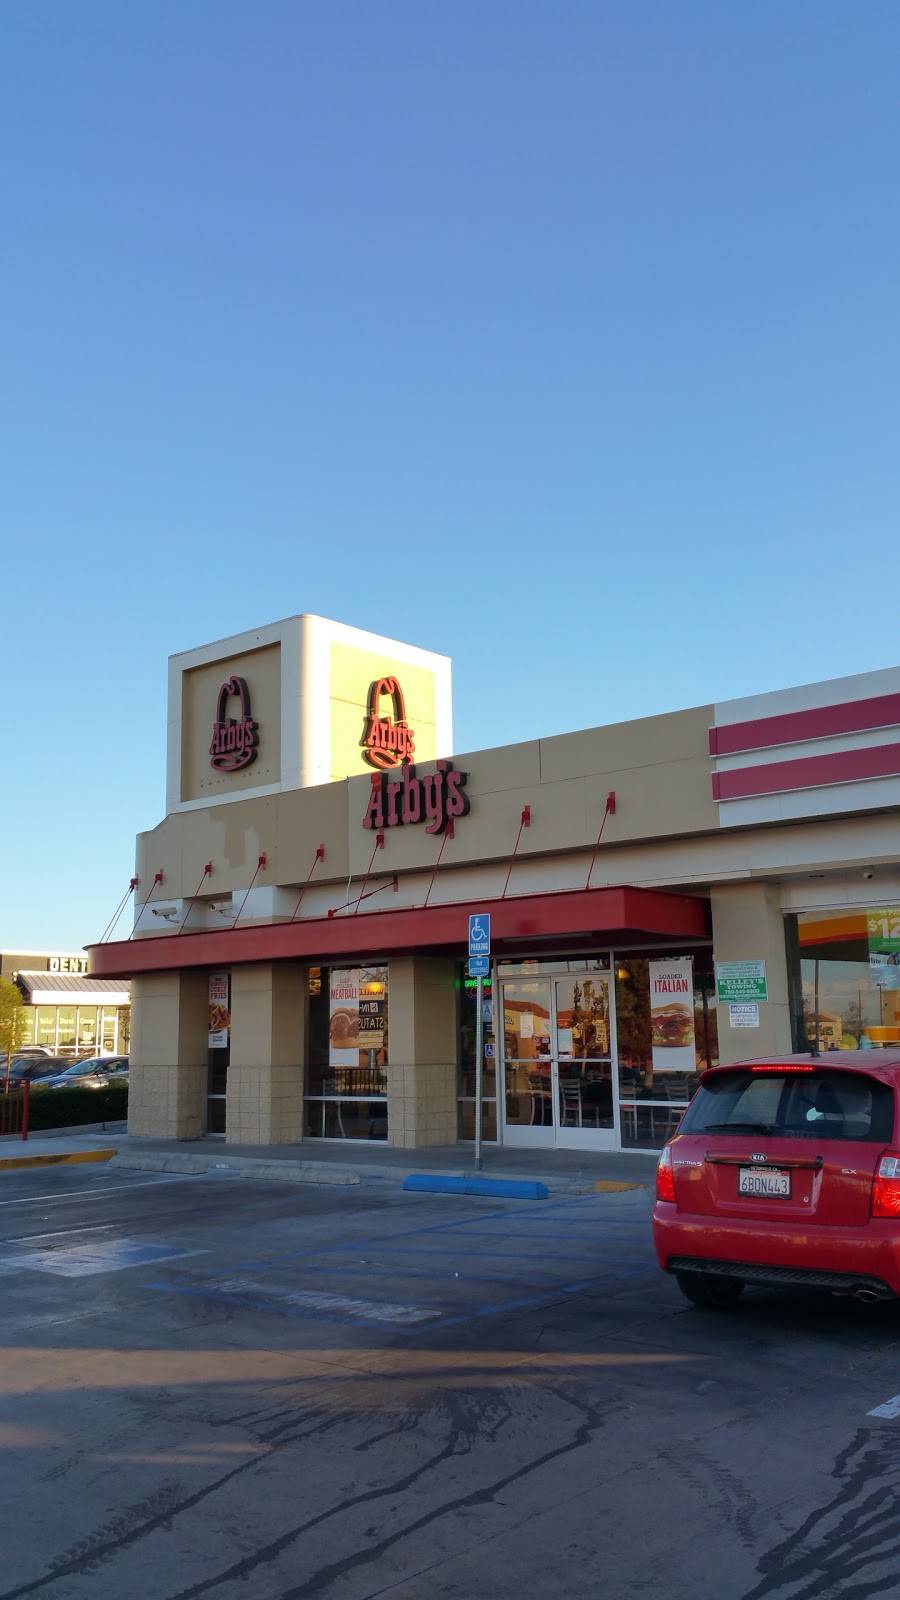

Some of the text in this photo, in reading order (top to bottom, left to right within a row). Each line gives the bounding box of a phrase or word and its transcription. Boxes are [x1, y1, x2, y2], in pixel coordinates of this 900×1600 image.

[209, 718, 257, 755] Arby's
[366, 714, 415, 760] Arby's
[363, 760, 467, 834] Arby's
[331, 988, 357, 1000] MEATBALL
[654, 979, 688, 992] ITALIAN
